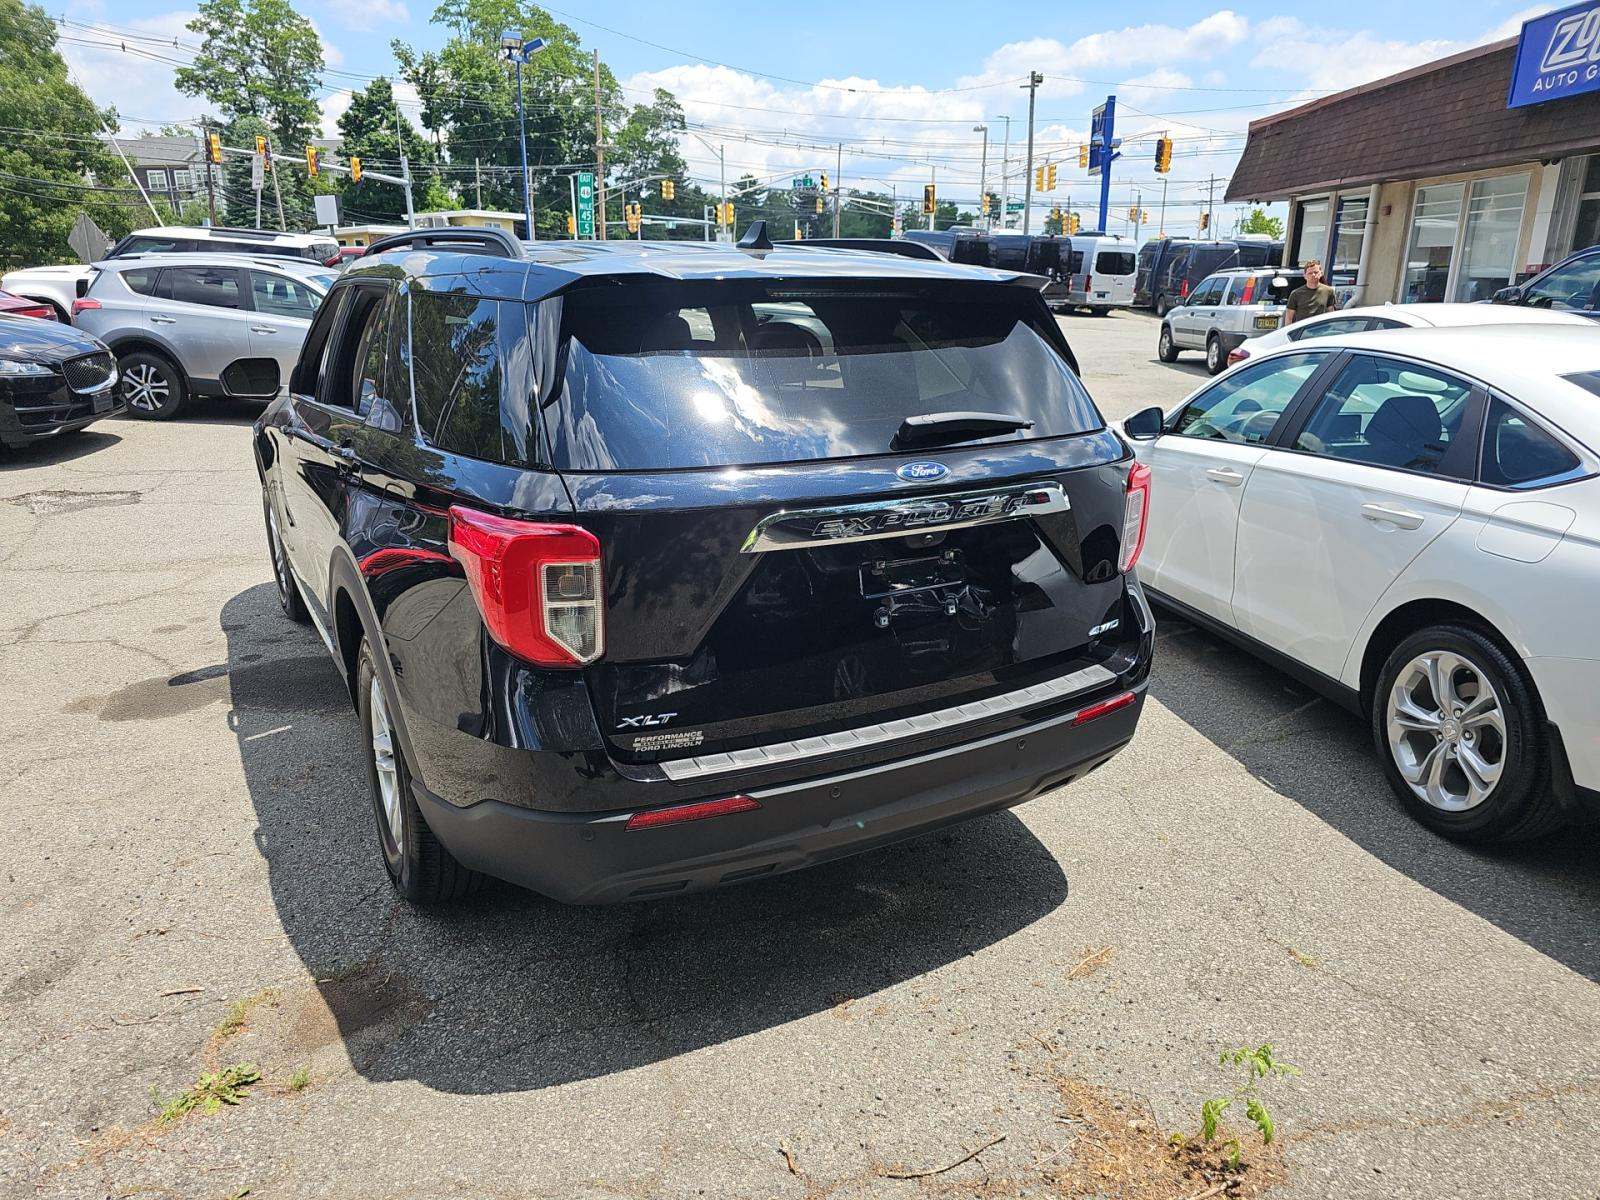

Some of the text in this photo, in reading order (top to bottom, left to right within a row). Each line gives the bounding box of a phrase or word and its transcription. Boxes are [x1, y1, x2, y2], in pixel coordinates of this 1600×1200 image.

[1532, 71, 1578, 92] AUTO
[581, 210, 592, 221] 45
[911, 464, 940, 477] Ford
[811, 493, 1030, 538] EXPLORER
[616, 712, 678, 729] XLT
[634, 730, 703, 744] PERFORMANCE
[635, 745, 660, 753] FORD
[663, 740, 702, 751] LINCOLN
